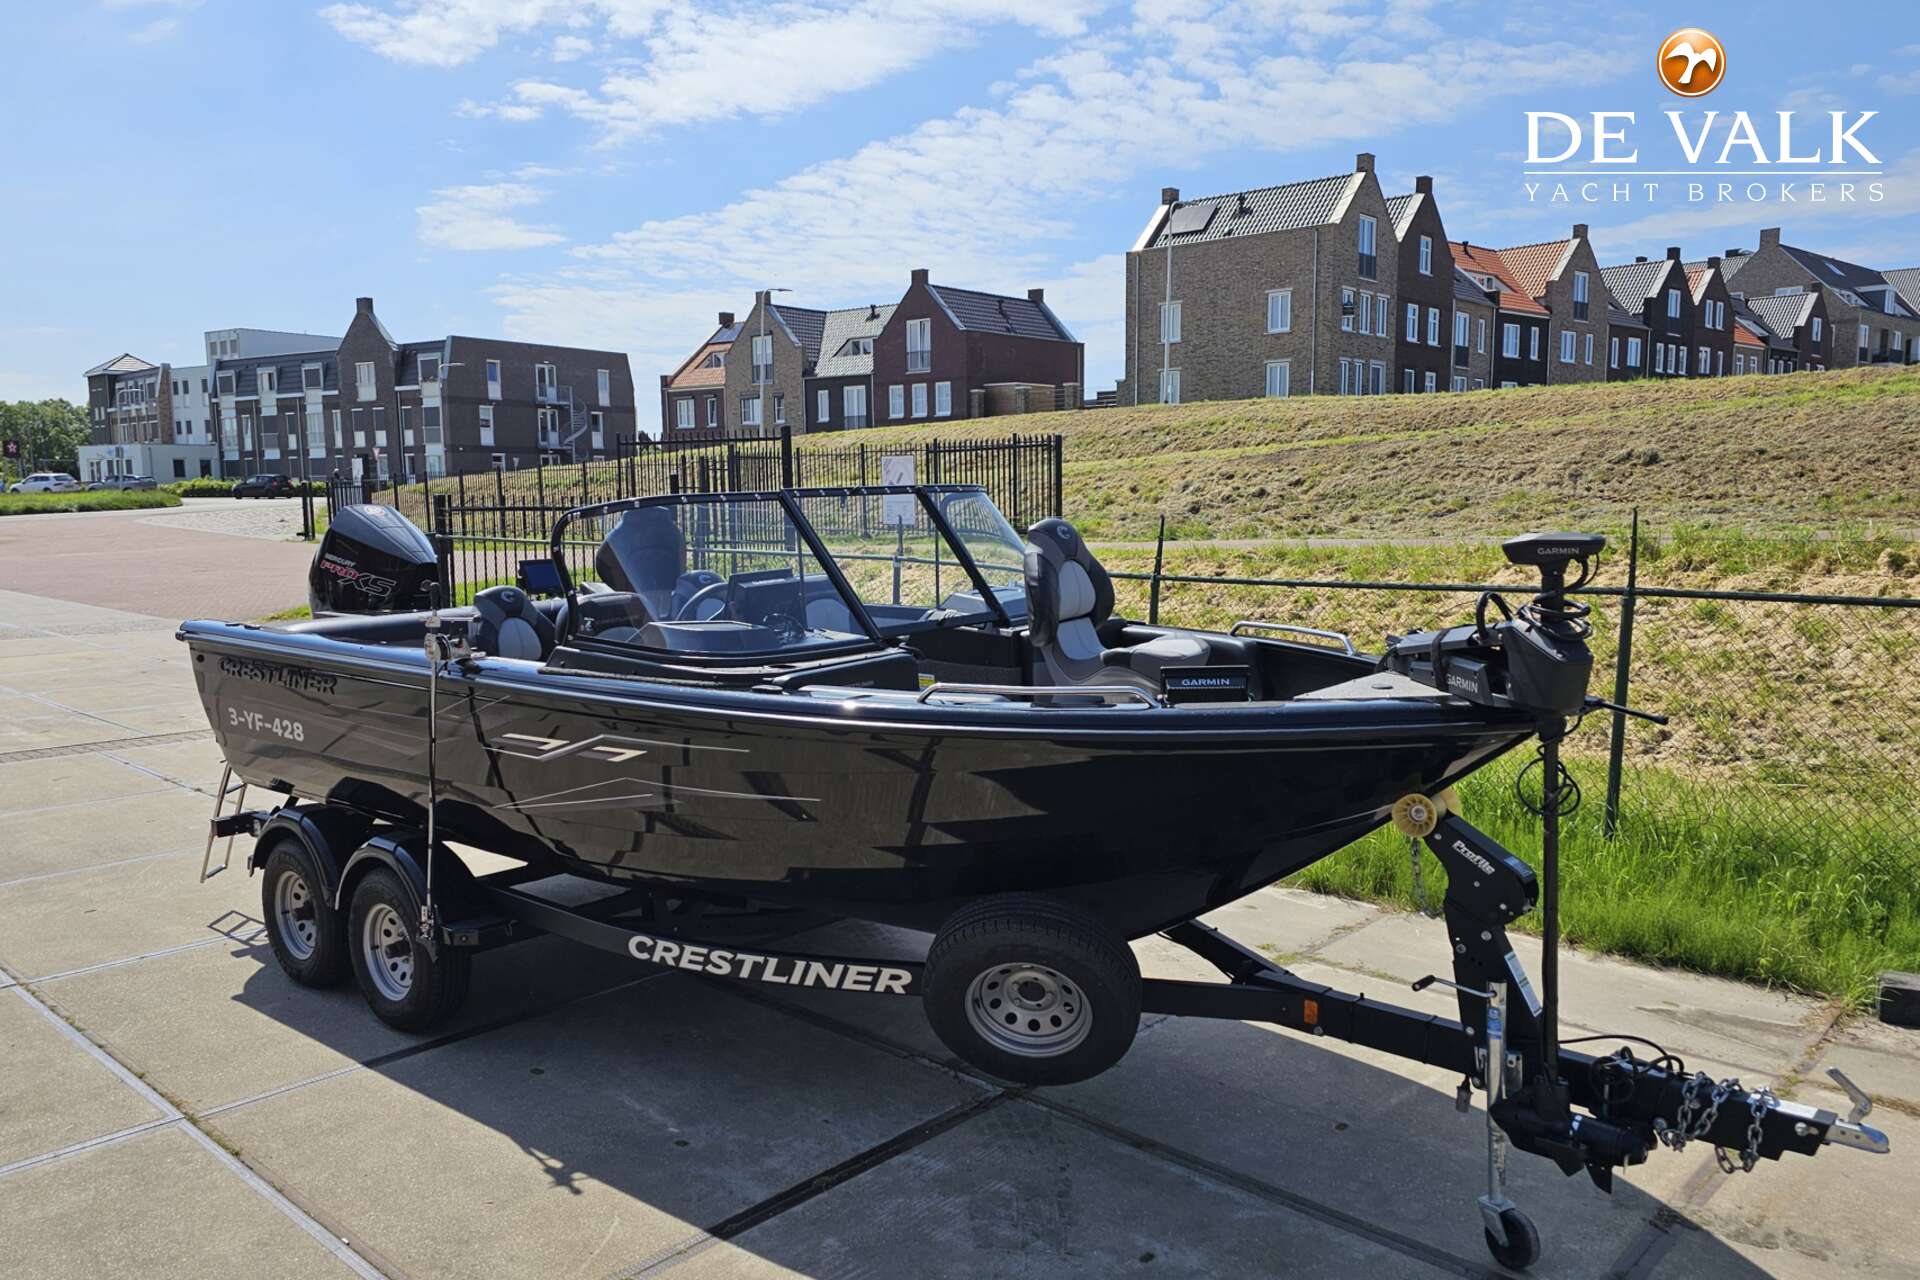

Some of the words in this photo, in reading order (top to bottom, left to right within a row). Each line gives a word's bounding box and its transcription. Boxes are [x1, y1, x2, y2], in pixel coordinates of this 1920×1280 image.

[324, 552, 357, 567] MERCURY
[1537, 547, 1580, 555] GARMIN
[320, 559, 360, 581] PRO
[337, 572, 397, 597] XS
[218, 655, 338, 695] CRESTLINER
[1182, 678, 1231, 686] GARMIN
[227, 706, 305, 742] 3-YF-428
[627, 934, 913, 995] CRESTLINER
